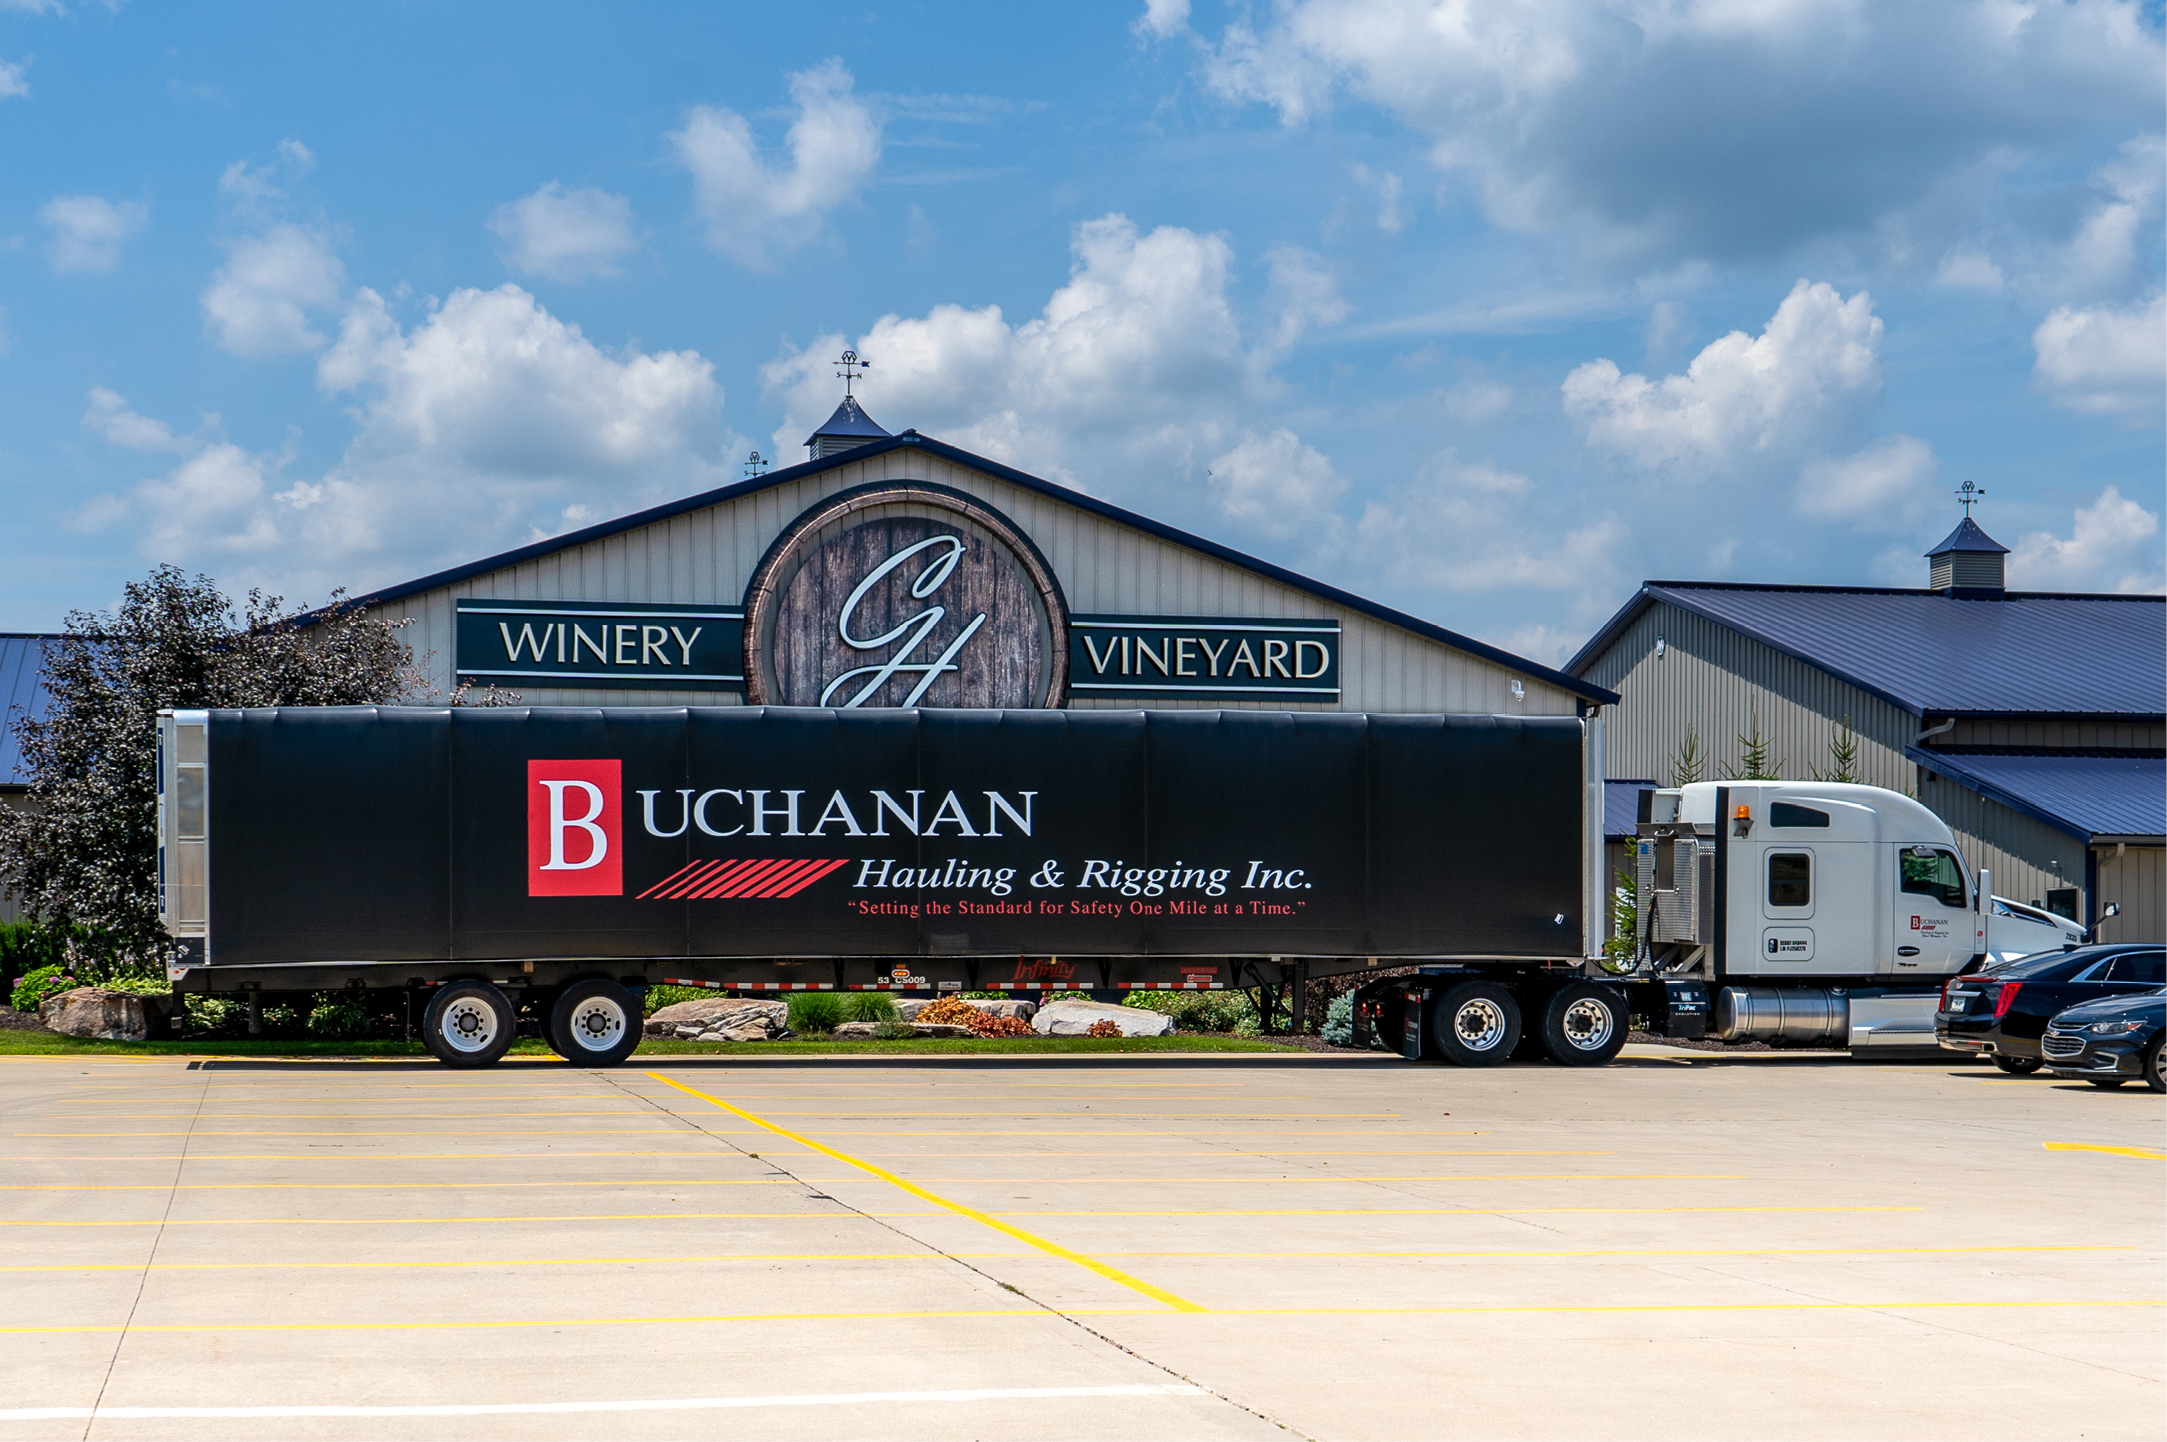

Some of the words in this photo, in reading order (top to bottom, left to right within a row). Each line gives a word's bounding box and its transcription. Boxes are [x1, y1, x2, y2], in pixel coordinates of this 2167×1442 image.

[499, 622, 702, 666] WINERY
[1083, 635, 1331, 679] VINEYARD
[538, 781, 1039, 870] BUCHANAN
[853, 859, 1017, 897] Hauling
[1030, 860, 1065, 888] &
[1077, 859, 1231, 897] Rigging
[1241, 861, 1313, 888] Inc.
[926, 901, 951, 915] the
[959, 901, 1032, 915] Standard
[1040, 901, 1064, 915] for
[1070, 901, 1123, 918] Safety
[1130, 901, 1162, 915] One
[1170, 901, 1207, 915] Mile
[1213, 903, 1228, 915] at
[1235, 905, 1244, 915] a
[877, 976, 890, 984] 53
[1012, 956, 1075, 981] Infinity
